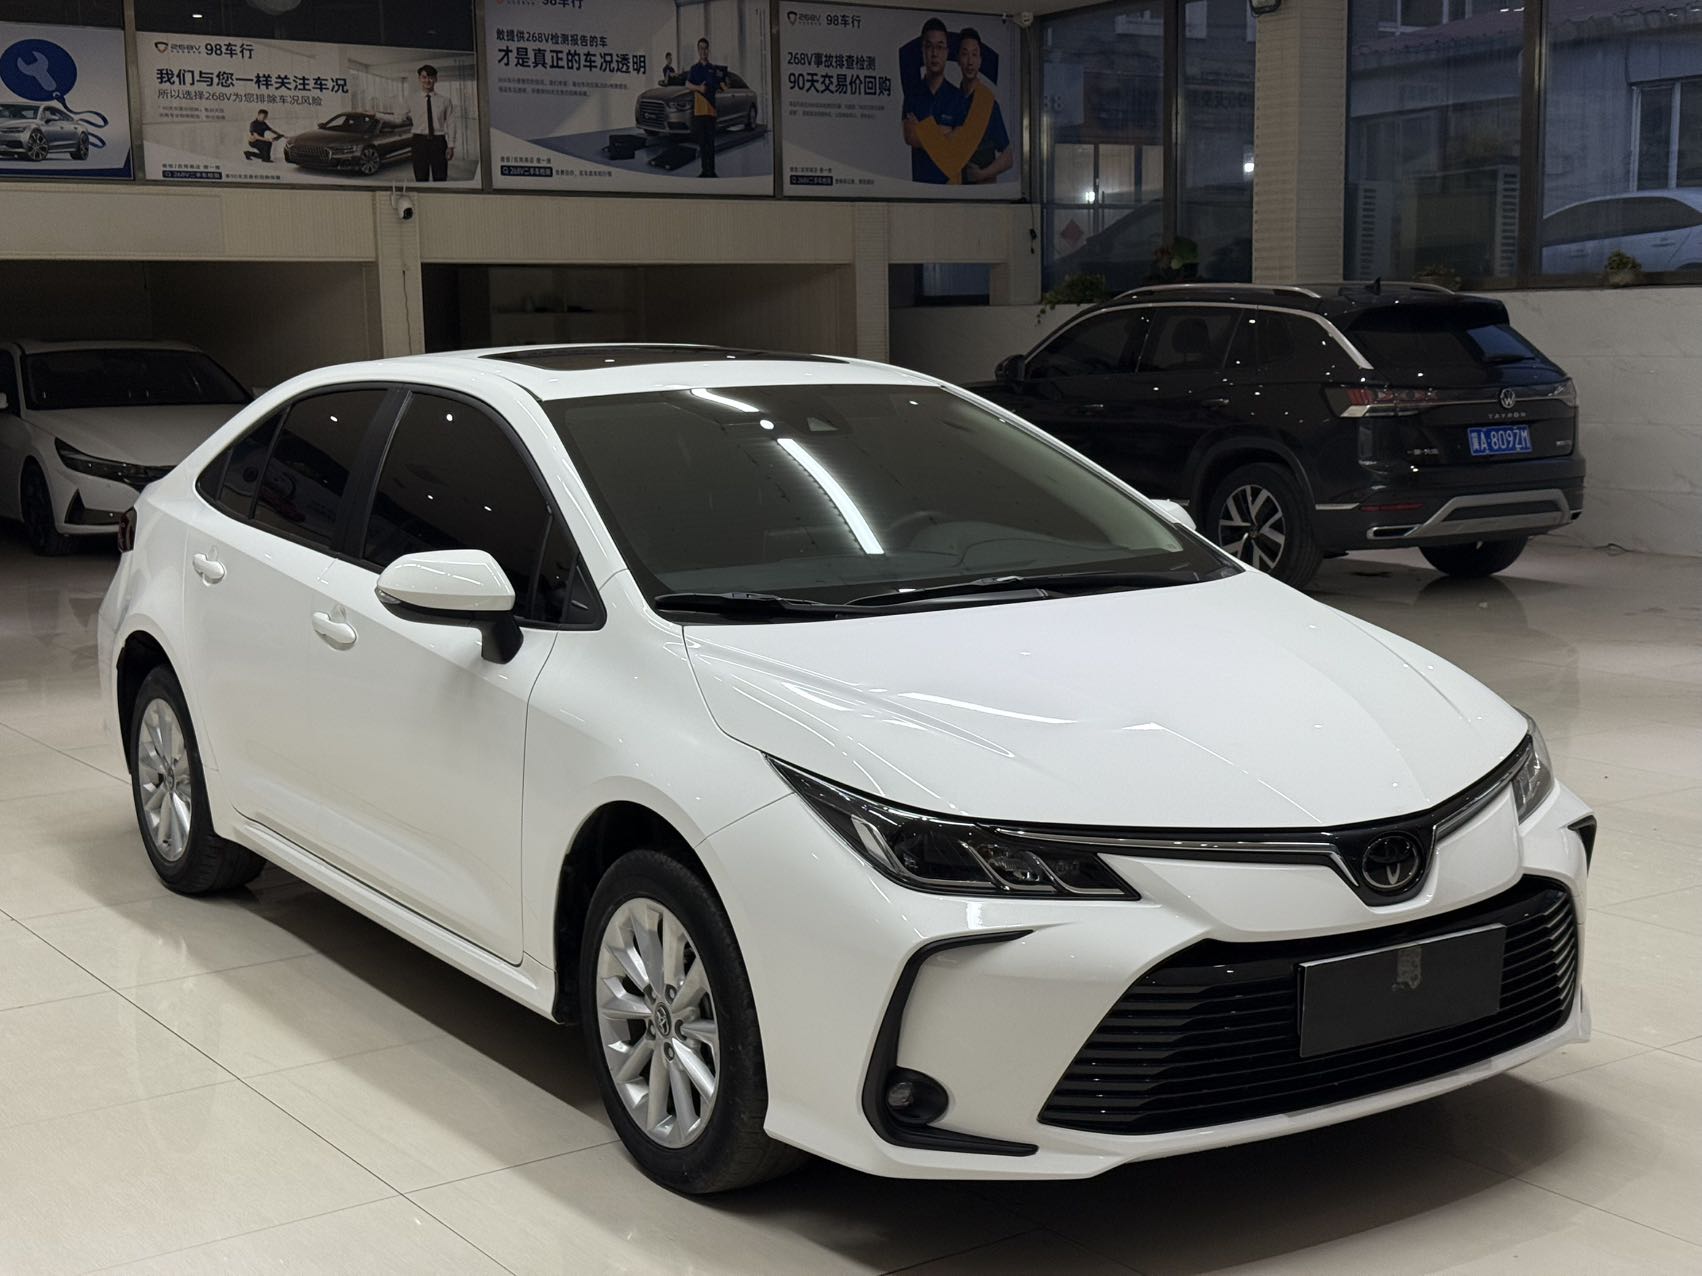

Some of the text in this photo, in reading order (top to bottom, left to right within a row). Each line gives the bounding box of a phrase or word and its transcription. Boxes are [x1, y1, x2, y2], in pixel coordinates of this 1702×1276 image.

[826, 14, 861, 29] 98车行
[496, 28, 608, 48] 敢提供268V检测报告的车
[205, 43, 254, 59] 98车行
[498, 46, 647, 75] 才是真正的车况透明
[787, 52, 876, 71] 268V事故排查检测
[156, 68, 349, 94] 我们与您一样关注车况
[788, 72, 892, 97] 90天交易价回购
[158, 89, 322, 106] 所以选择268V为您排除车况风险
